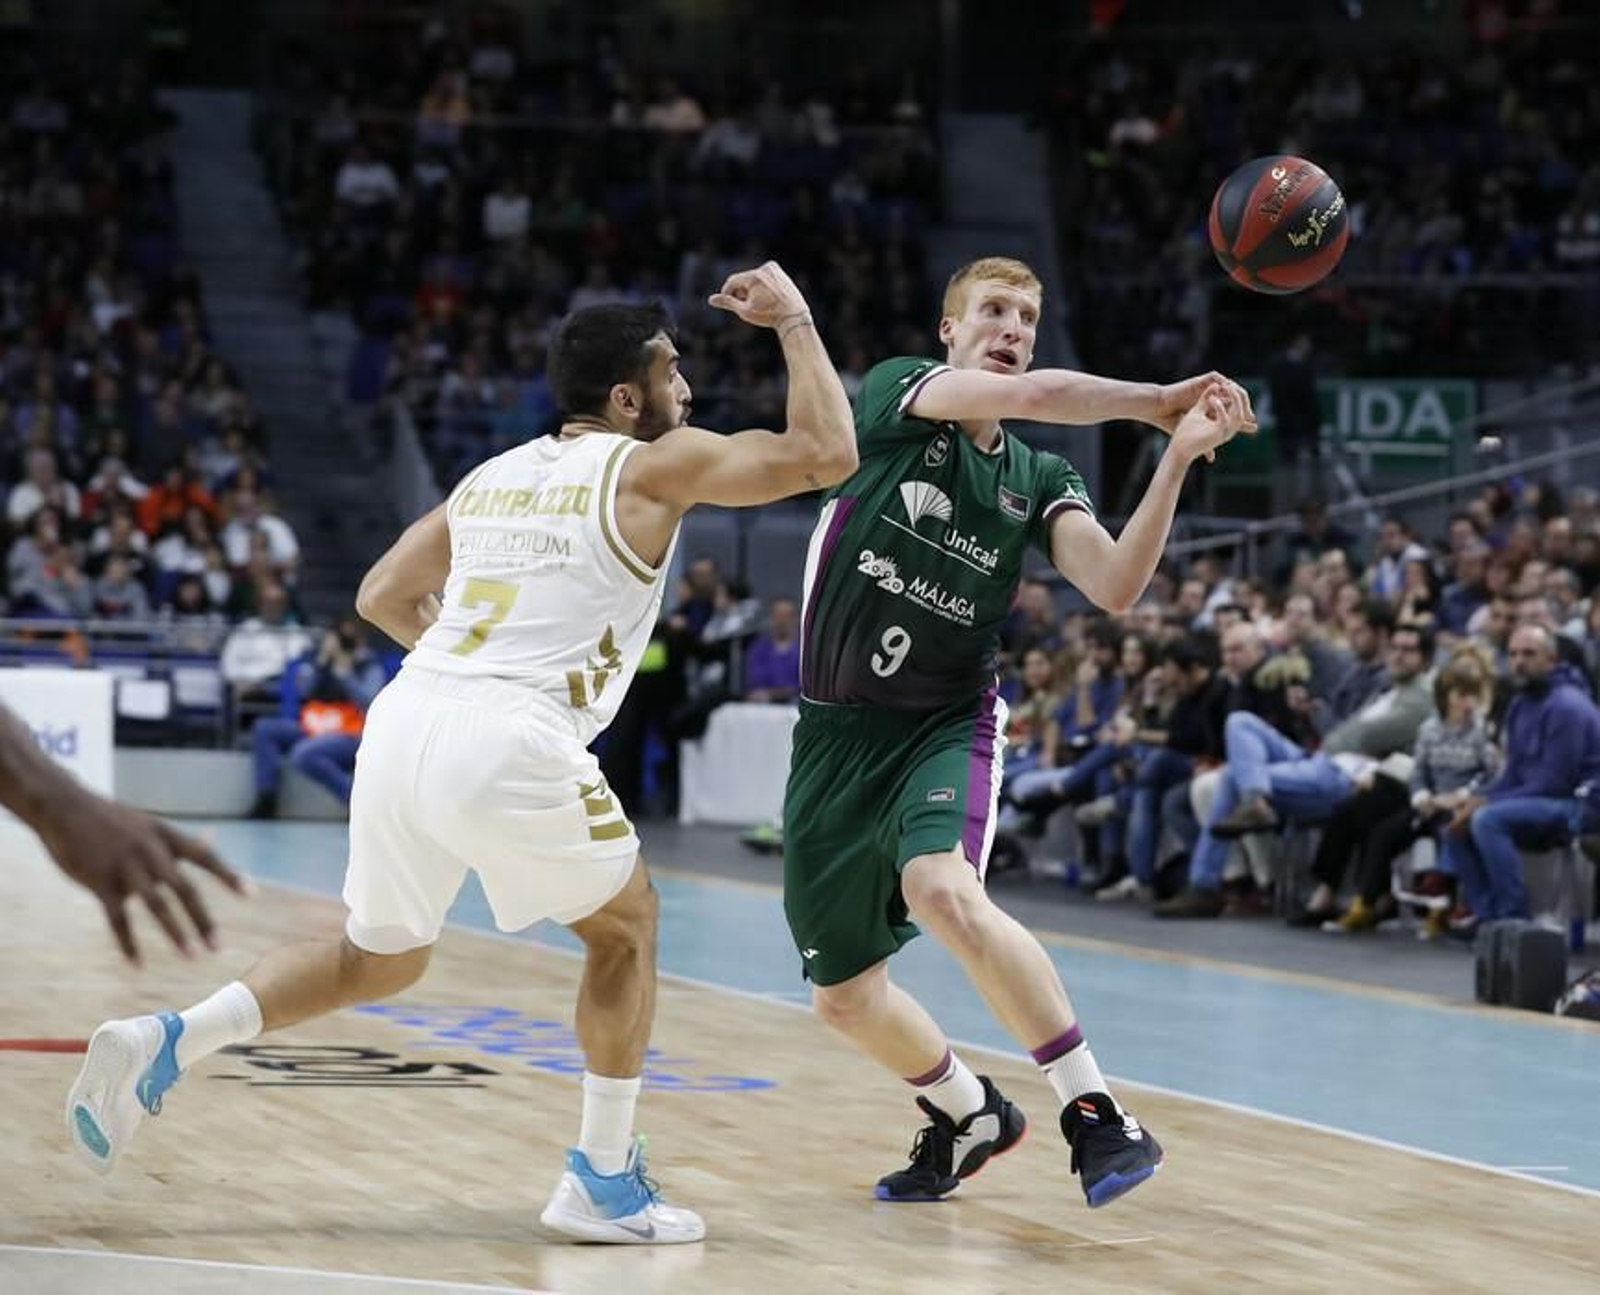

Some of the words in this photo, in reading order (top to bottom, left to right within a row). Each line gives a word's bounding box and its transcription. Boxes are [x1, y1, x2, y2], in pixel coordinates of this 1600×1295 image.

[457, 484, 594, 518] CAMPAZZO
[450, 576, 521, 656] 7
[908, 576, 976, 620] MÁLAGA
[870, 625, 912, 678] 9
